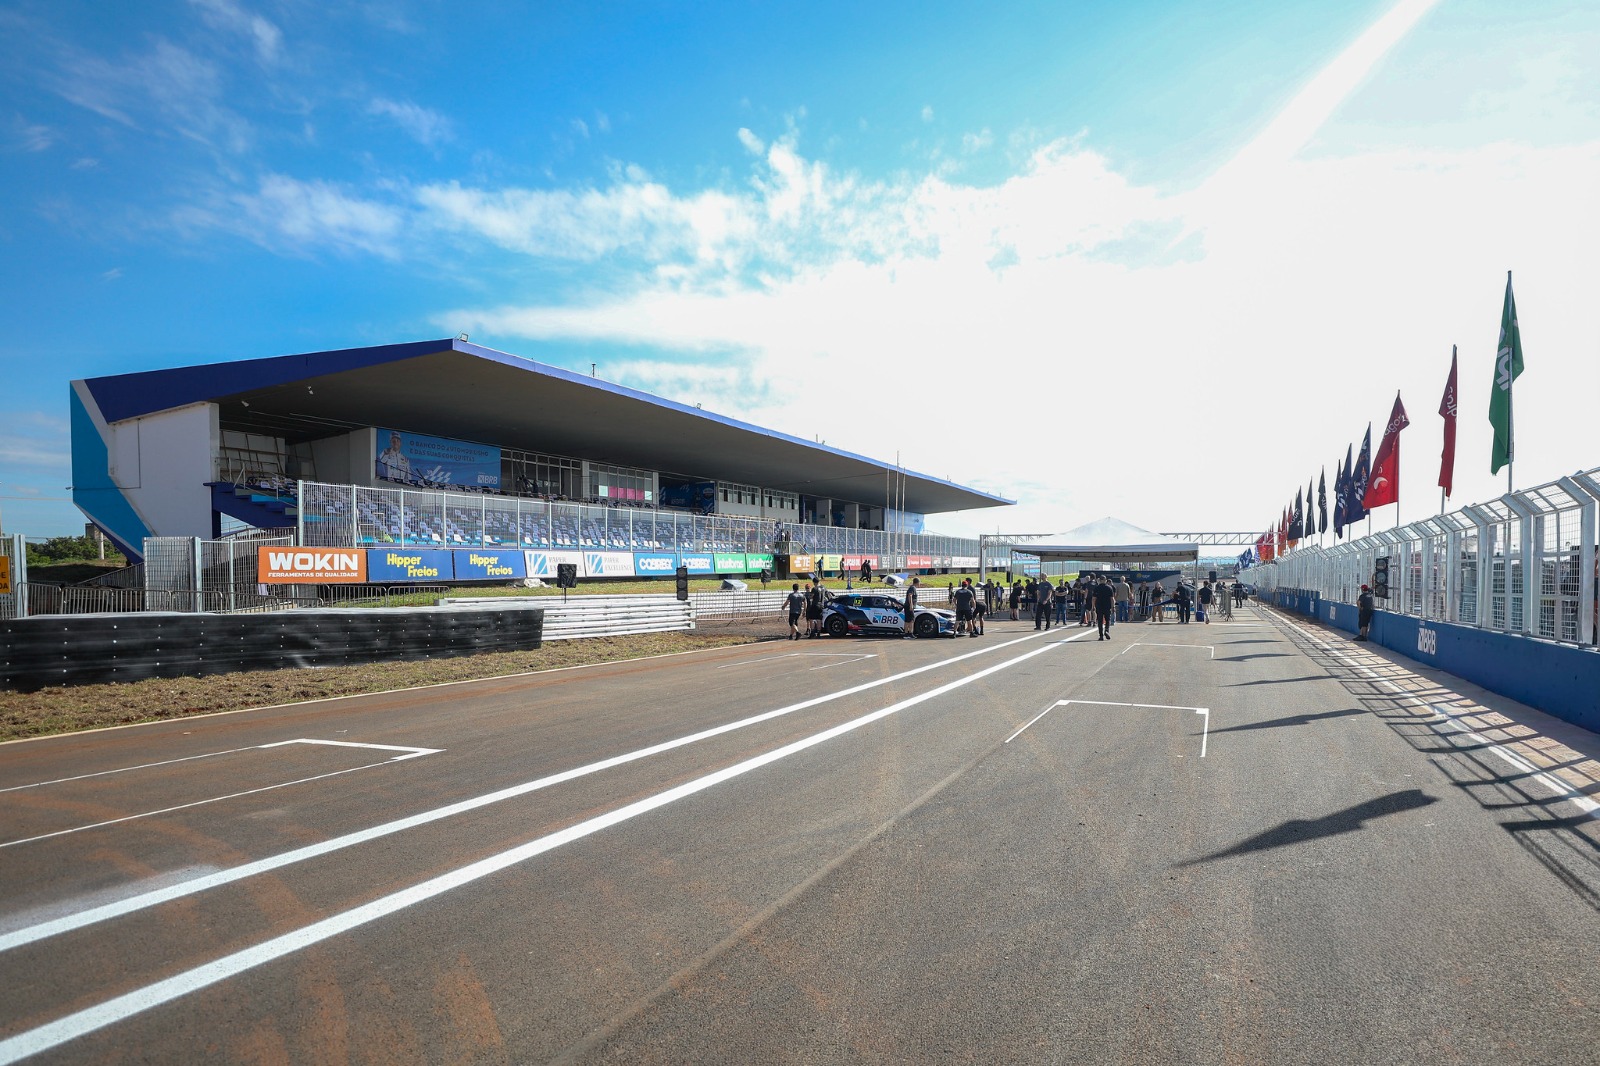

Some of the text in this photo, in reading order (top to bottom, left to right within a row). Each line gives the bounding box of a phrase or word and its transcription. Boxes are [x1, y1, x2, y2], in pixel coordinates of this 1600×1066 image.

[415, 441, 436, 449] BANCO
[485, 475, 498, 485] BRB
[268, 552, 359, 571] WOKIN
[387, 553, 421, 568] Hipper
[469, 553, 498, 567] Hipper
[407, 565, 438, 577] Freios
[487, 564, 513, 576] Freios
[880, 615, 899, 625] BRB
